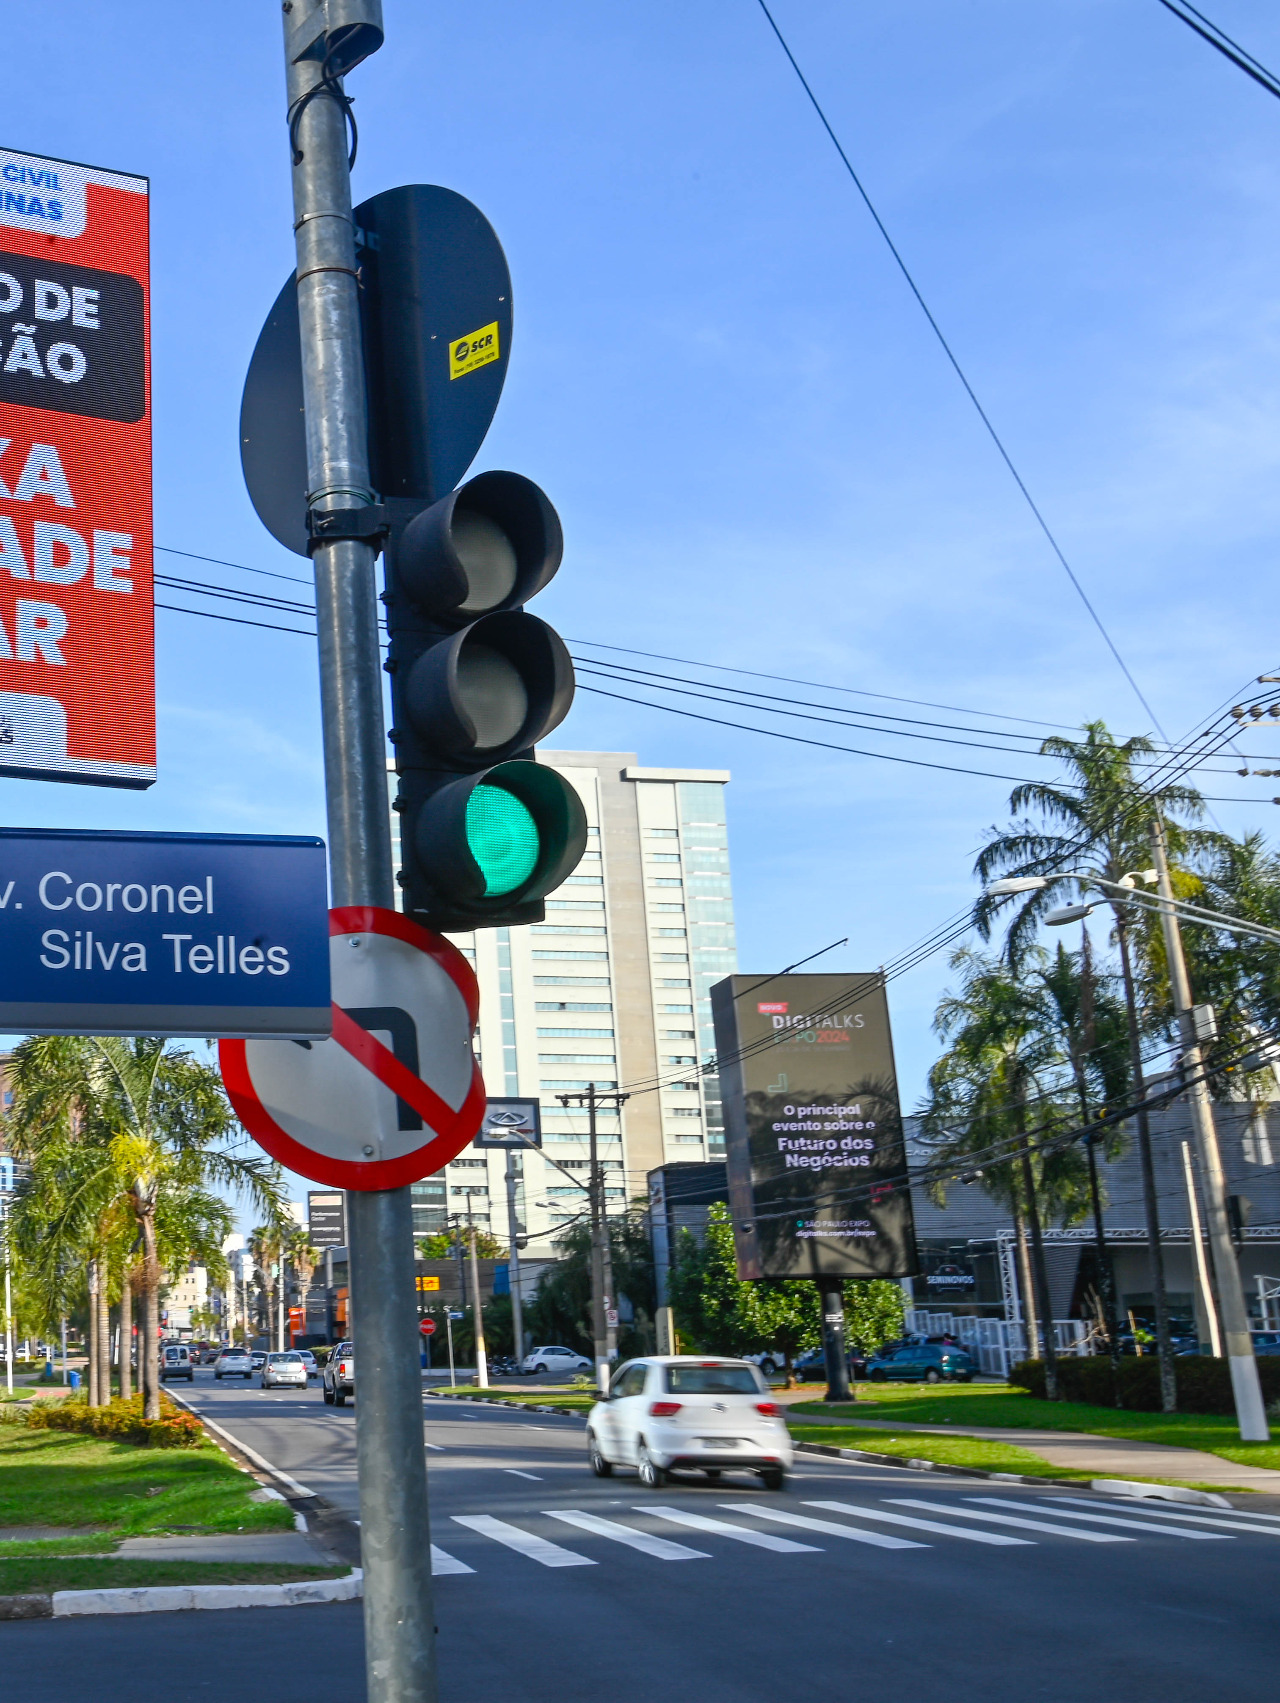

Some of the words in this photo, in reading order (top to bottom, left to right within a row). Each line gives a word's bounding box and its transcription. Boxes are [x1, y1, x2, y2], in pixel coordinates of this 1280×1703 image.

[2, 163, 63, 192] CIVIL
[34, 279, 101, 331] DE
[470, 333, 493, 353] SCR
[38, 871, 215, 914] Coronel
[39, 928, 147, 973] Silva
[161, 933, 290, 977] Telles
[772, 1014, 865, 1029] DIGITALKS
[783, 1105, 796, 1116] O
[797, 1103, 861, 1119] principal
[772, 1120, 822, 1132] evento
[823, 1119, 864, 1131] sobre
[865, 1121, 876, 1130] o
[777, 1137, 838, 1151] Futuro
[840, 1135, 874, 1150] dos
[784, 1152, 870, 1171] Negócios
[804, 1219, 821, 1227] SÃO
